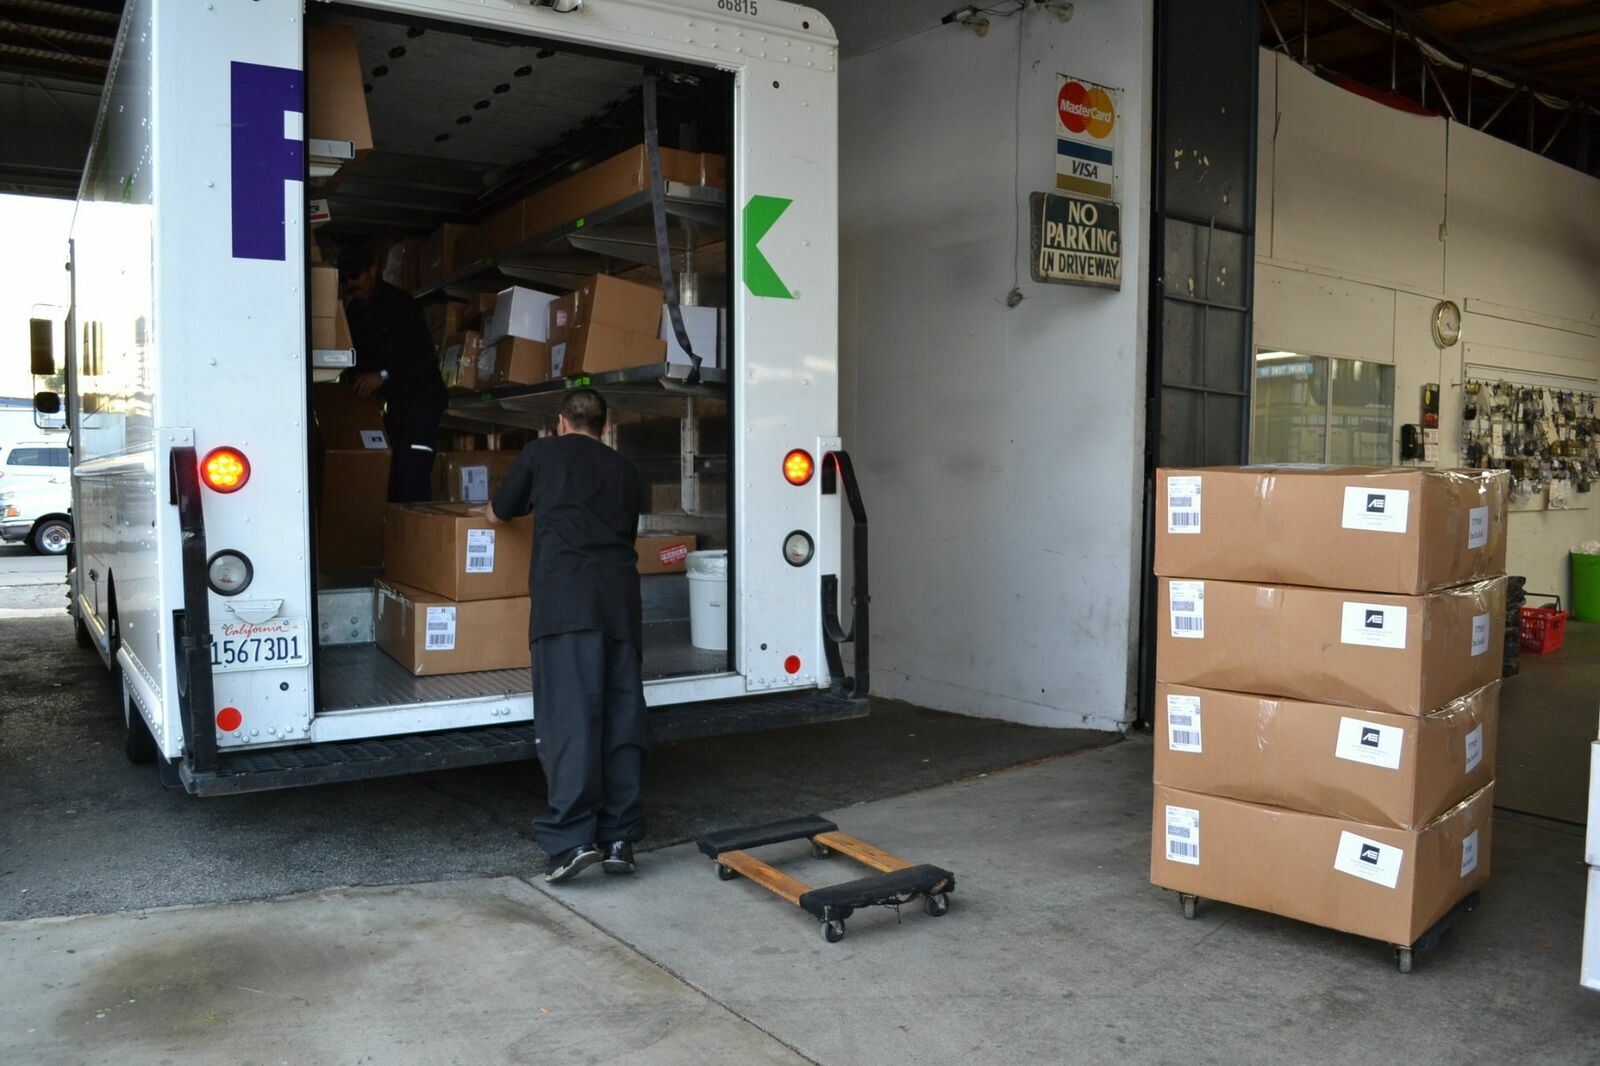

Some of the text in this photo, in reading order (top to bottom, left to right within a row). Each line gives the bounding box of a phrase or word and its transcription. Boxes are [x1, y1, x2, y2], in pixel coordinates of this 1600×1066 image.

[1060, 99, 1112, 123] MasterCard
[1072, 160, 1098, 180] VISA
[1068, 201, 1098, 226] NO
[1046, 221, 1118, 254] PARKING
[1042, 250, 1119, 279] IN DRIVEWAY
[224, 623, 289, 638] California
[211, 635, 302, 665] 15673D1
